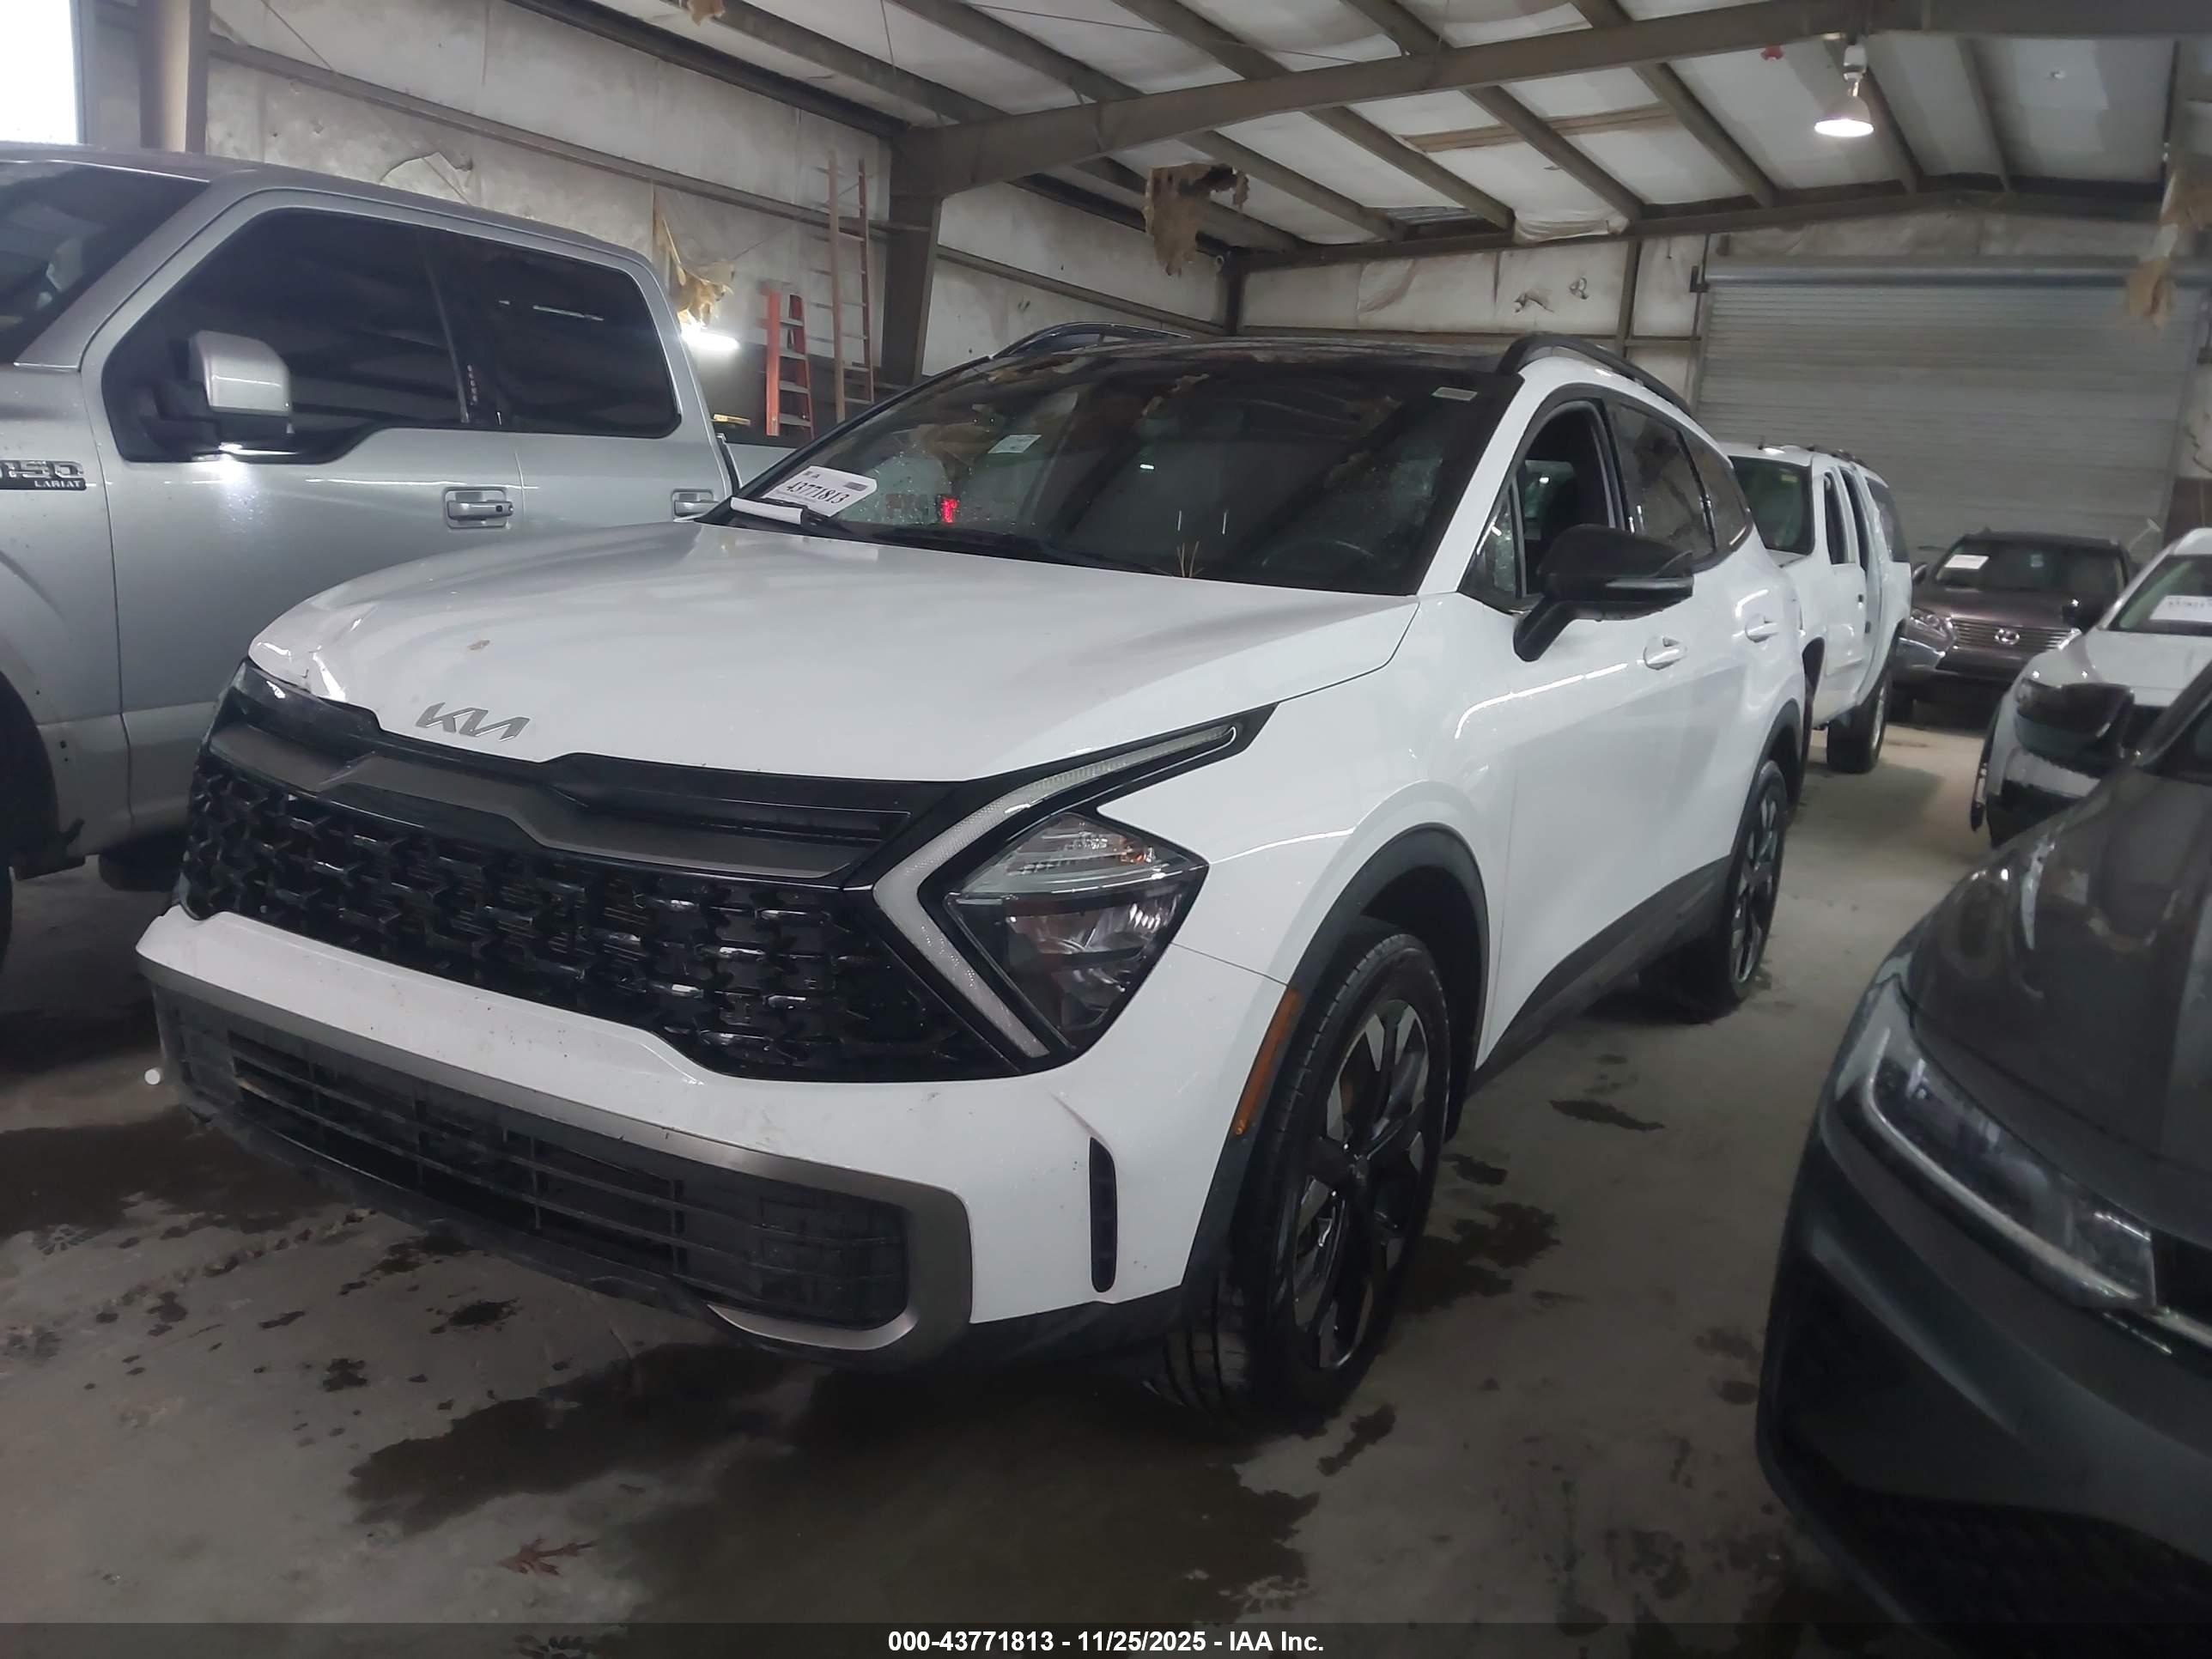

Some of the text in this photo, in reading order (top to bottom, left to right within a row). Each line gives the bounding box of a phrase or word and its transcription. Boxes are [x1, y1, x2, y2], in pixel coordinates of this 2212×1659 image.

[0, 460, 84, 479] 150
[787, 481, 849, 504] 43771813
[416, 702, 531, 742] KIA
